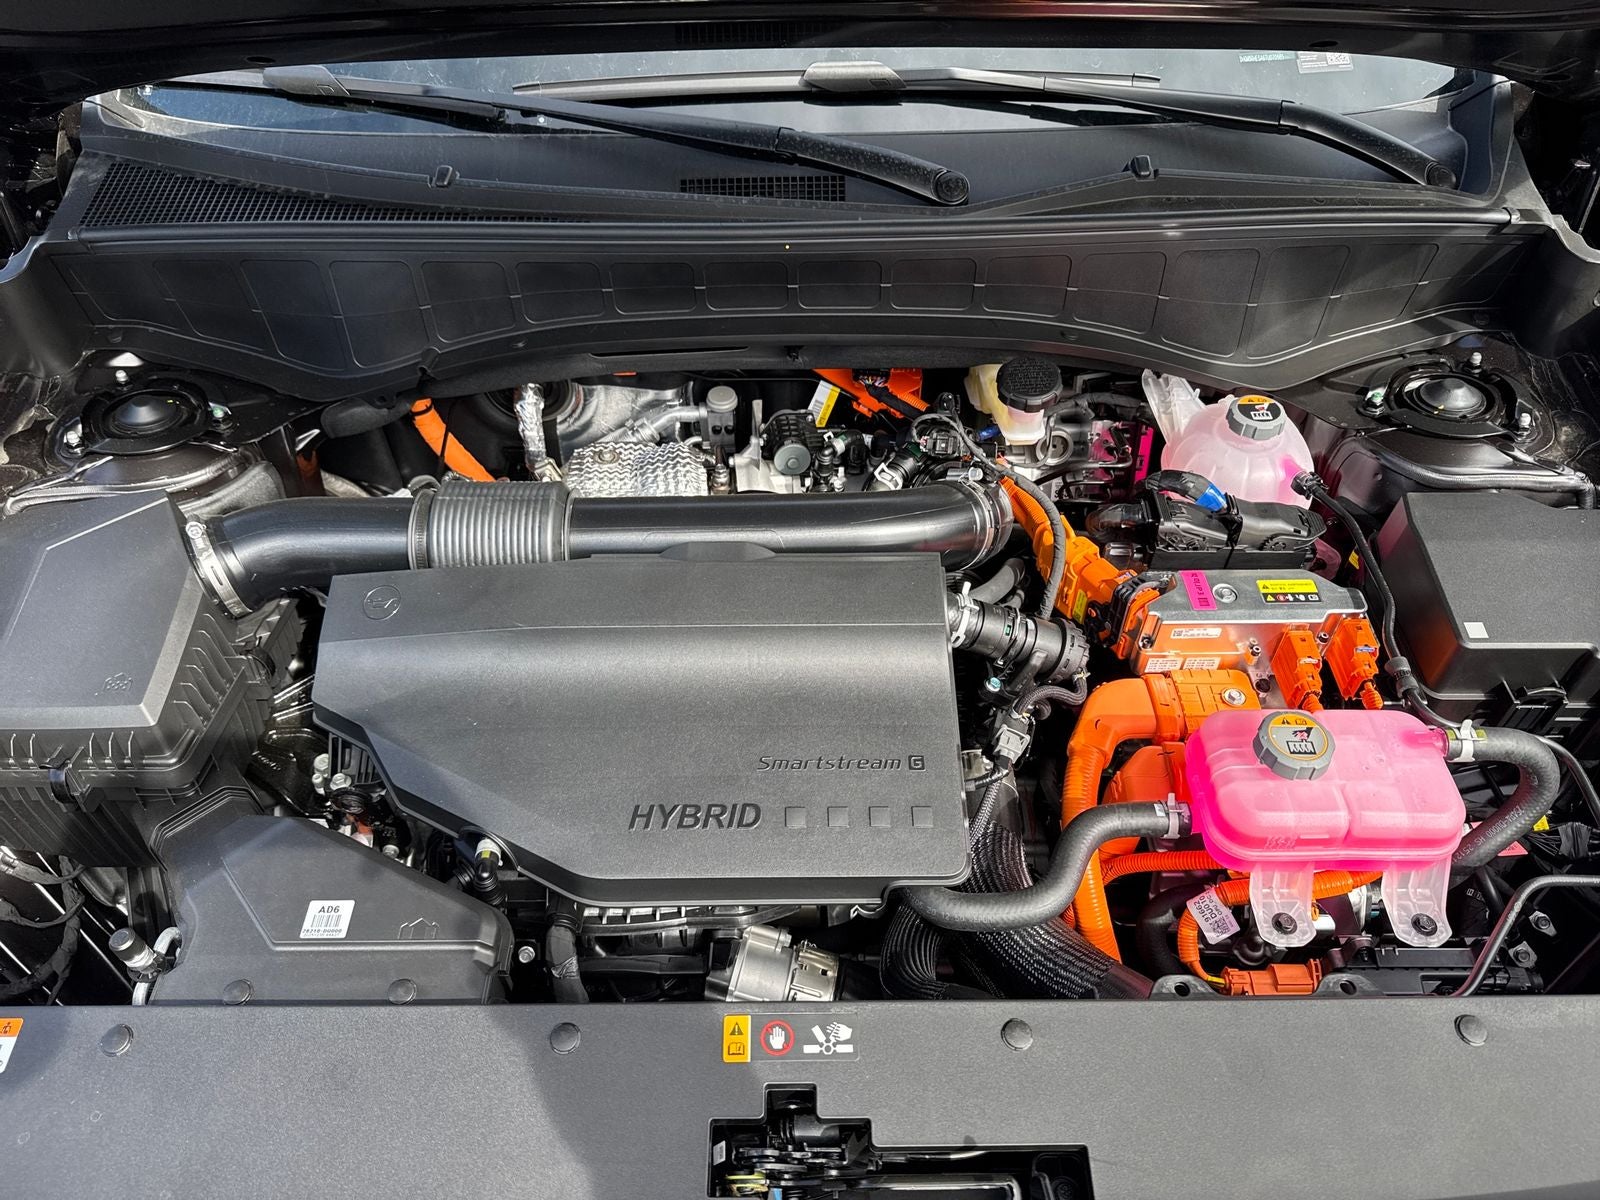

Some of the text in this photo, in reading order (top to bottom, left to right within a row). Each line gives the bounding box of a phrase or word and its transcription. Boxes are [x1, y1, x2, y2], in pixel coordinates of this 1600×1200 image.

[757, 755, 925, 771] Smartstream G
[628, 803, 762, 830] HYBRID
[318, 905, 340, 914] AD6
[1193, 900, 1212, 922] 91662
[1199, 895, 1217, 919] DU010
